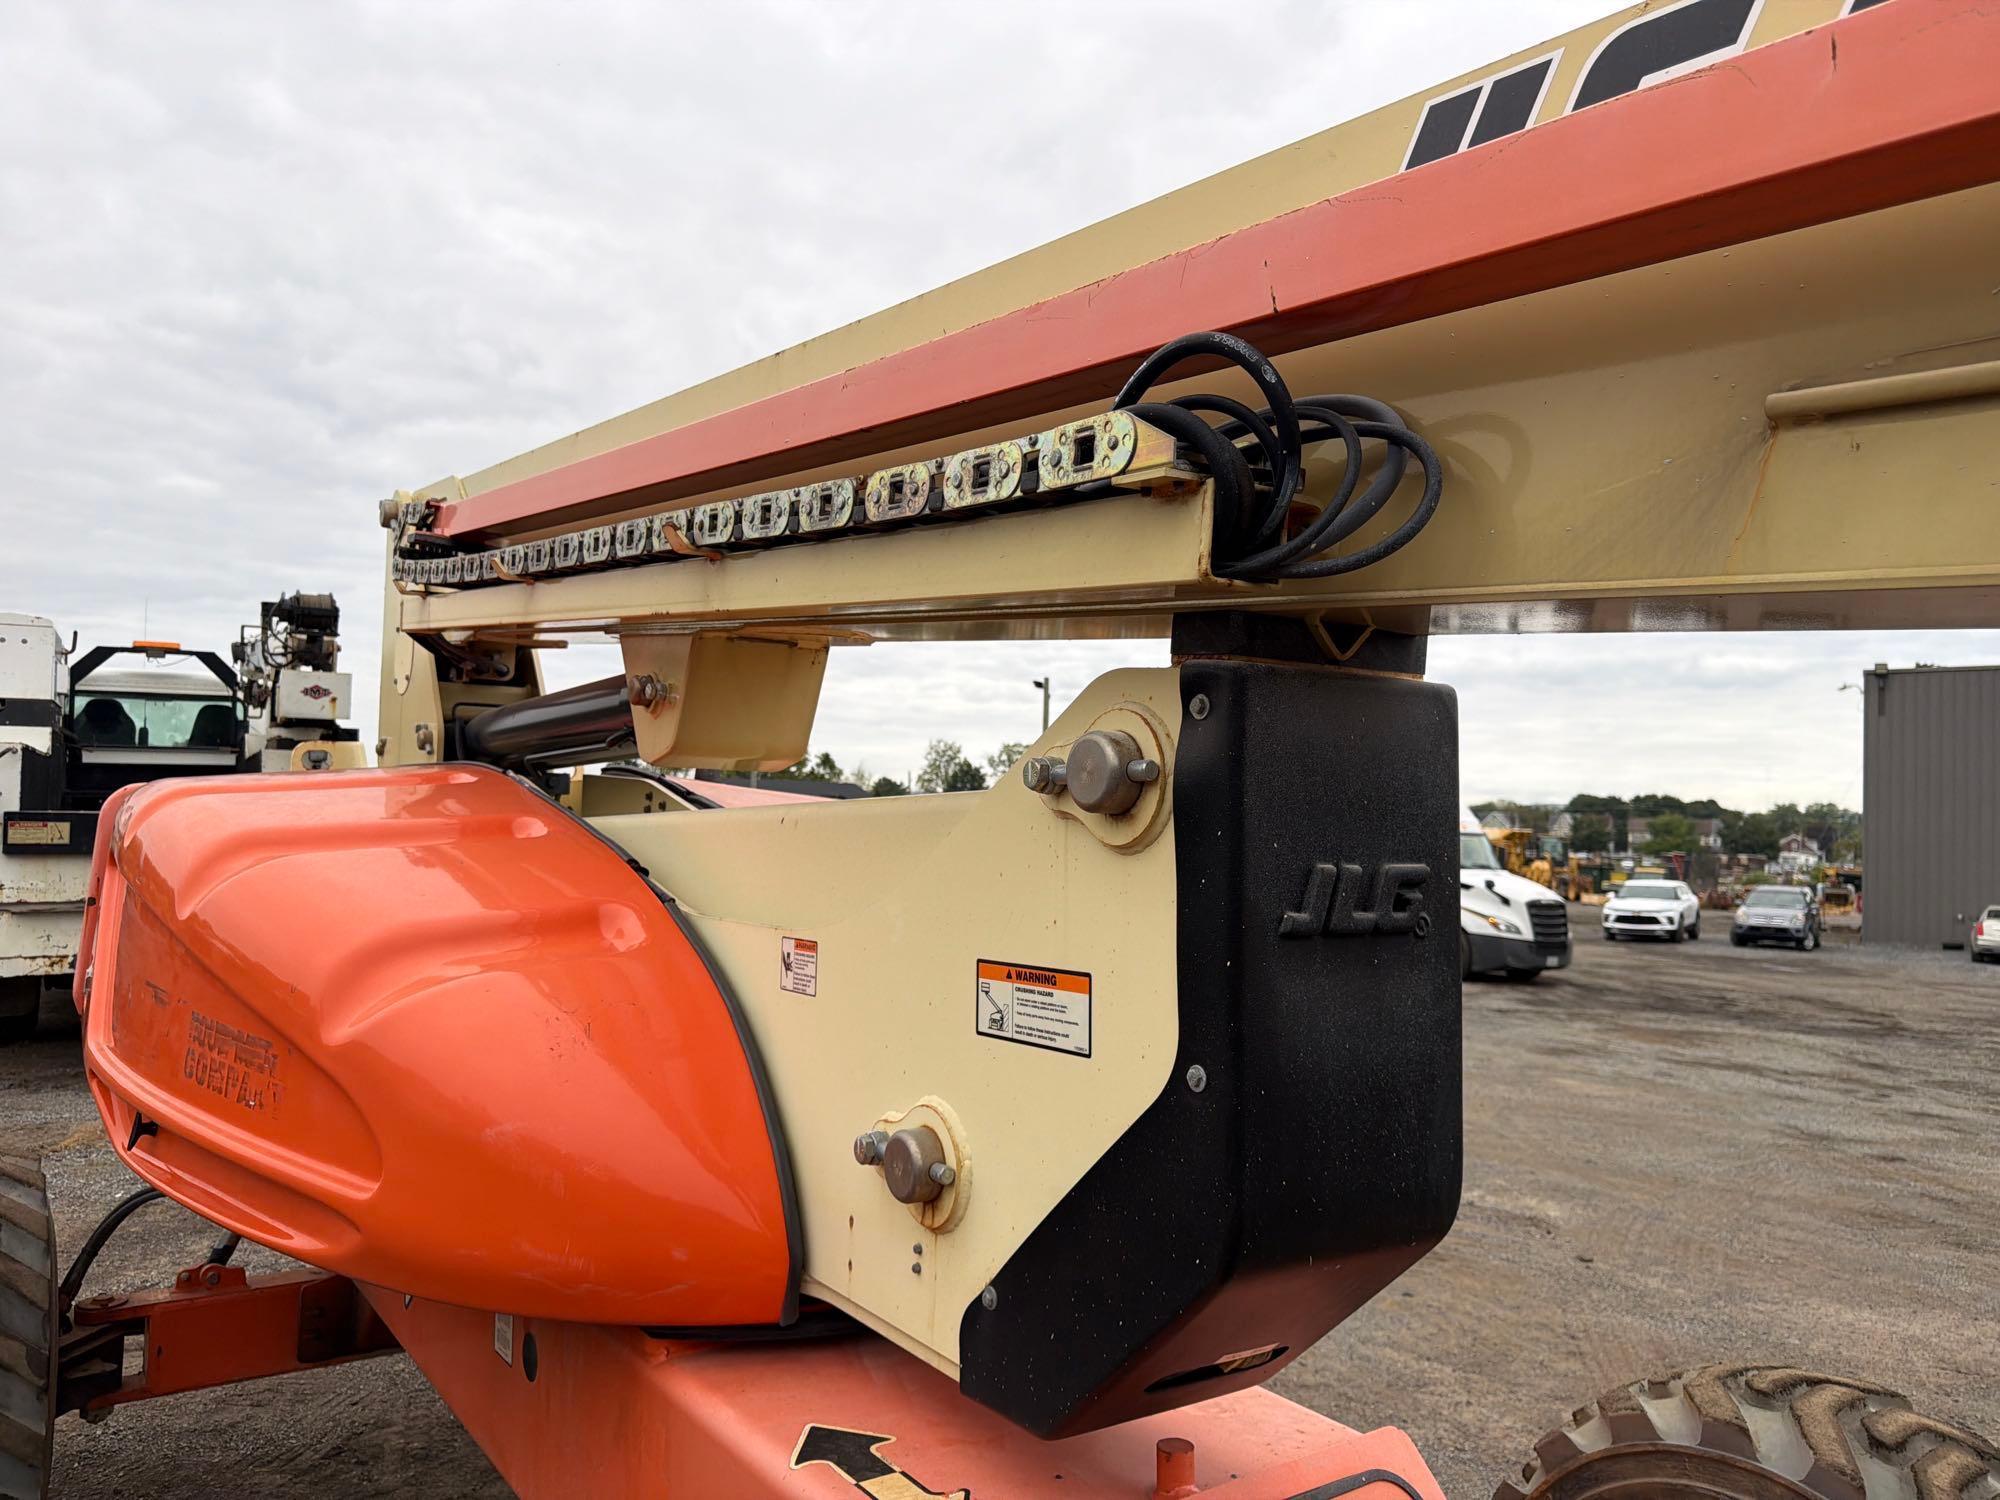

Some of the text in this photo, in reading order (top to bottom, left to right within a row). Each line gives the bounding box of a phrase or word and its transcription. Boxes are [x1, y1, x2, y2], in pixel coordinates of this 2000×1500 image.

[1278, 863, 1431, 935] JLG
[1015, 969, 1057, 986] WARNING
[1037, 989, 1054, 998] HAZARD
